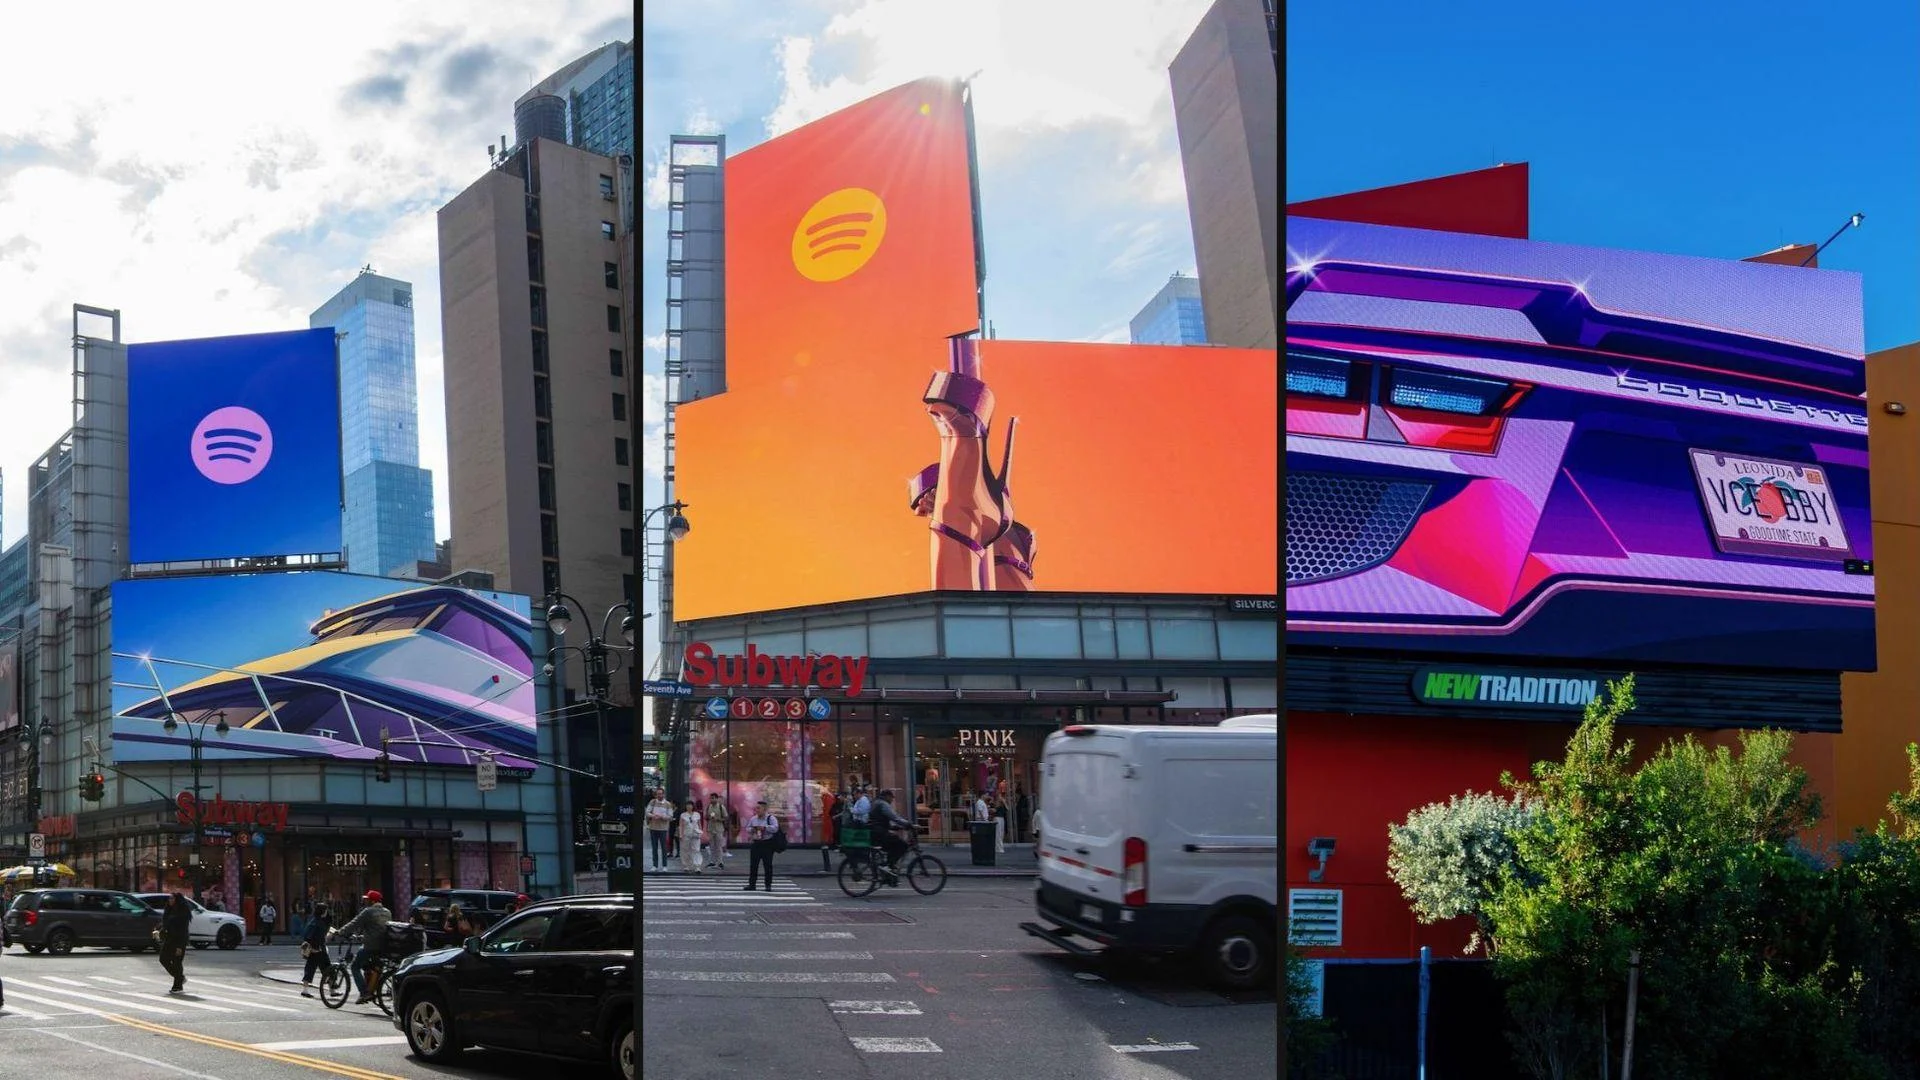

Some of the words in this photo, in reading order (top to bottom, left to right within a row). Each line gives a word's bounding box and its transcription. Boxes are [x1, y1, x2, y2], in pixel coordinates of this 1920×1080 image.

[1617, 376, 1868, 426] COQUETTE
[1734, 462, 1795, 482] LEONIDA
[1750, 526, 1792, 542] GOODTIME
[1793, 531, 1818, 545] STATE
[683, 641, 869, 697] Subway
[643, 683, 675, 693] Seventh
[676, 686, 692, 694] Ave
[738, 702, 747, 715] 1
[764, 702, 775, 715] 2
[790, 701, 801, 715] 3
[809, 699, 827, 716] MTA
[959, 729, 1016, 746] PINK
[176, 791, 290, 831] Subway
[334, 853, 368, 865] PINK
